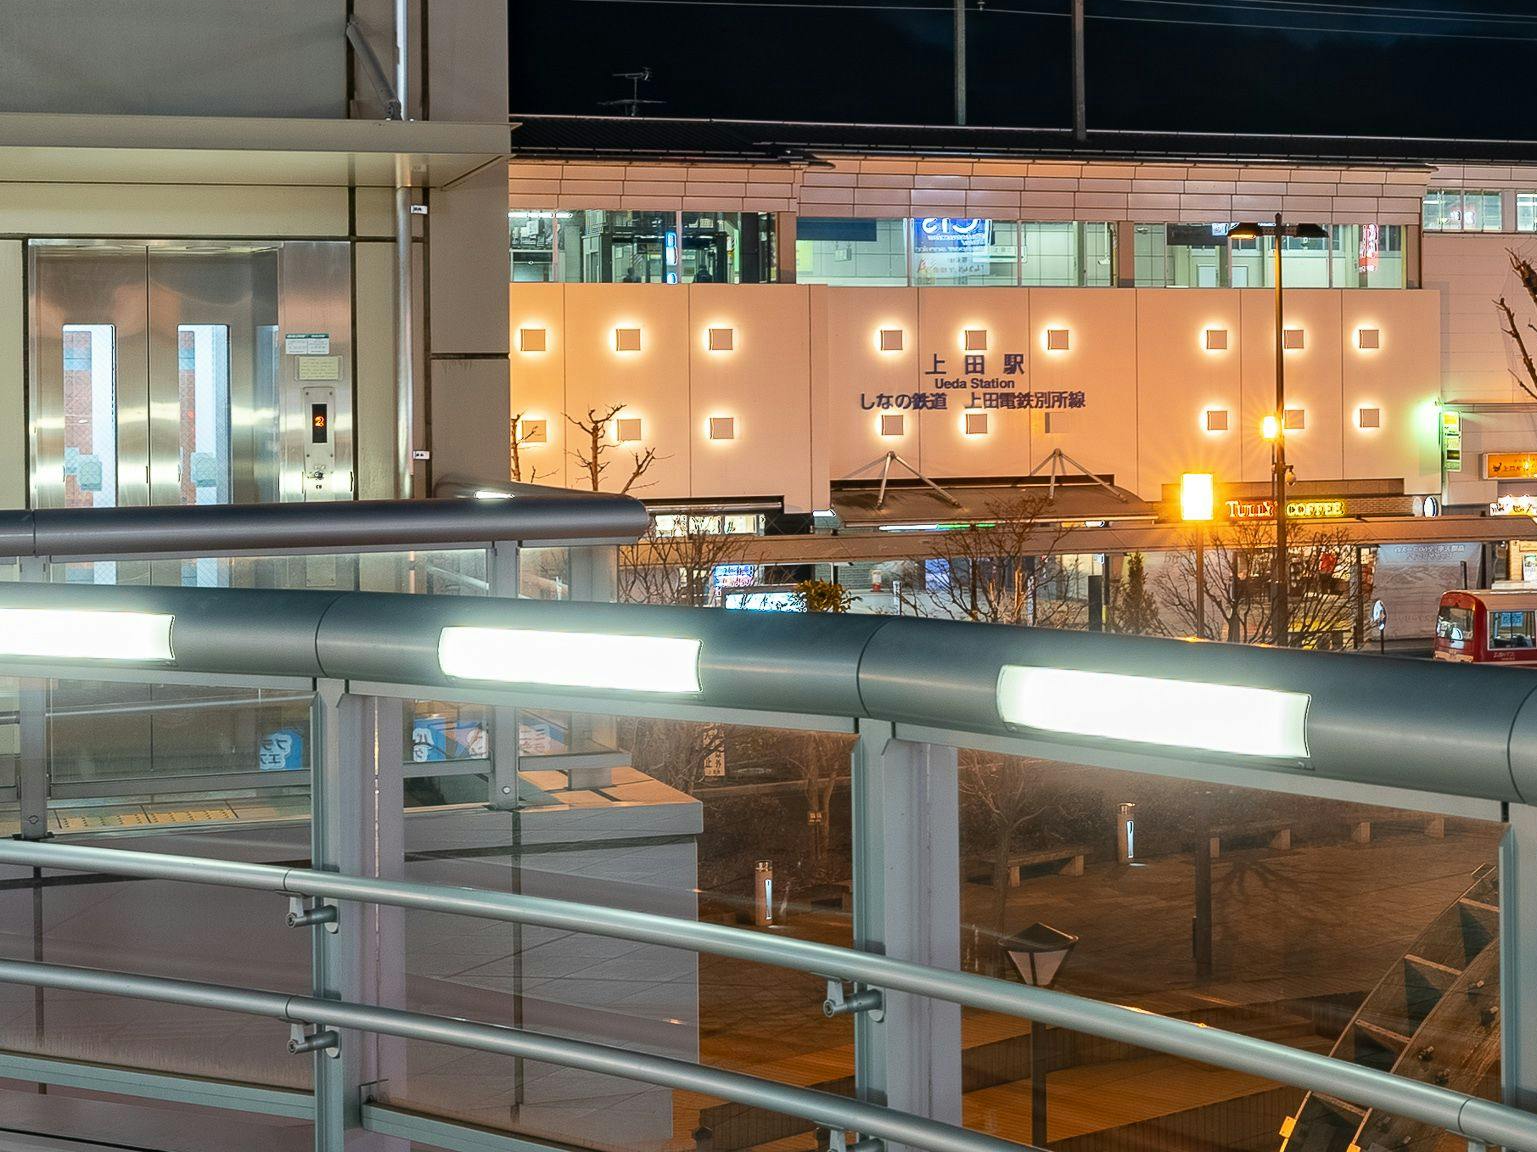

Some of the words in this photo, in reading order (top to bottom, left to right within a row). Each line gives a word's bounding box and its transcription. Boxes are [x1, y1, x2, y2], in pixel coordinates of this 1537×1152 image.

[924, 353, 1025, 376] 上田駅
[934, 378, 967, 390] Ueda
[970, 378, 1016, 390] Station
[859, 392, 948, 411] しなの鉄道
[964, 390, 1087, 410] 上田電鉄別所線
[314, 415, 325, 428] 2
[1286, 501, 1345, 518] COFFEE
